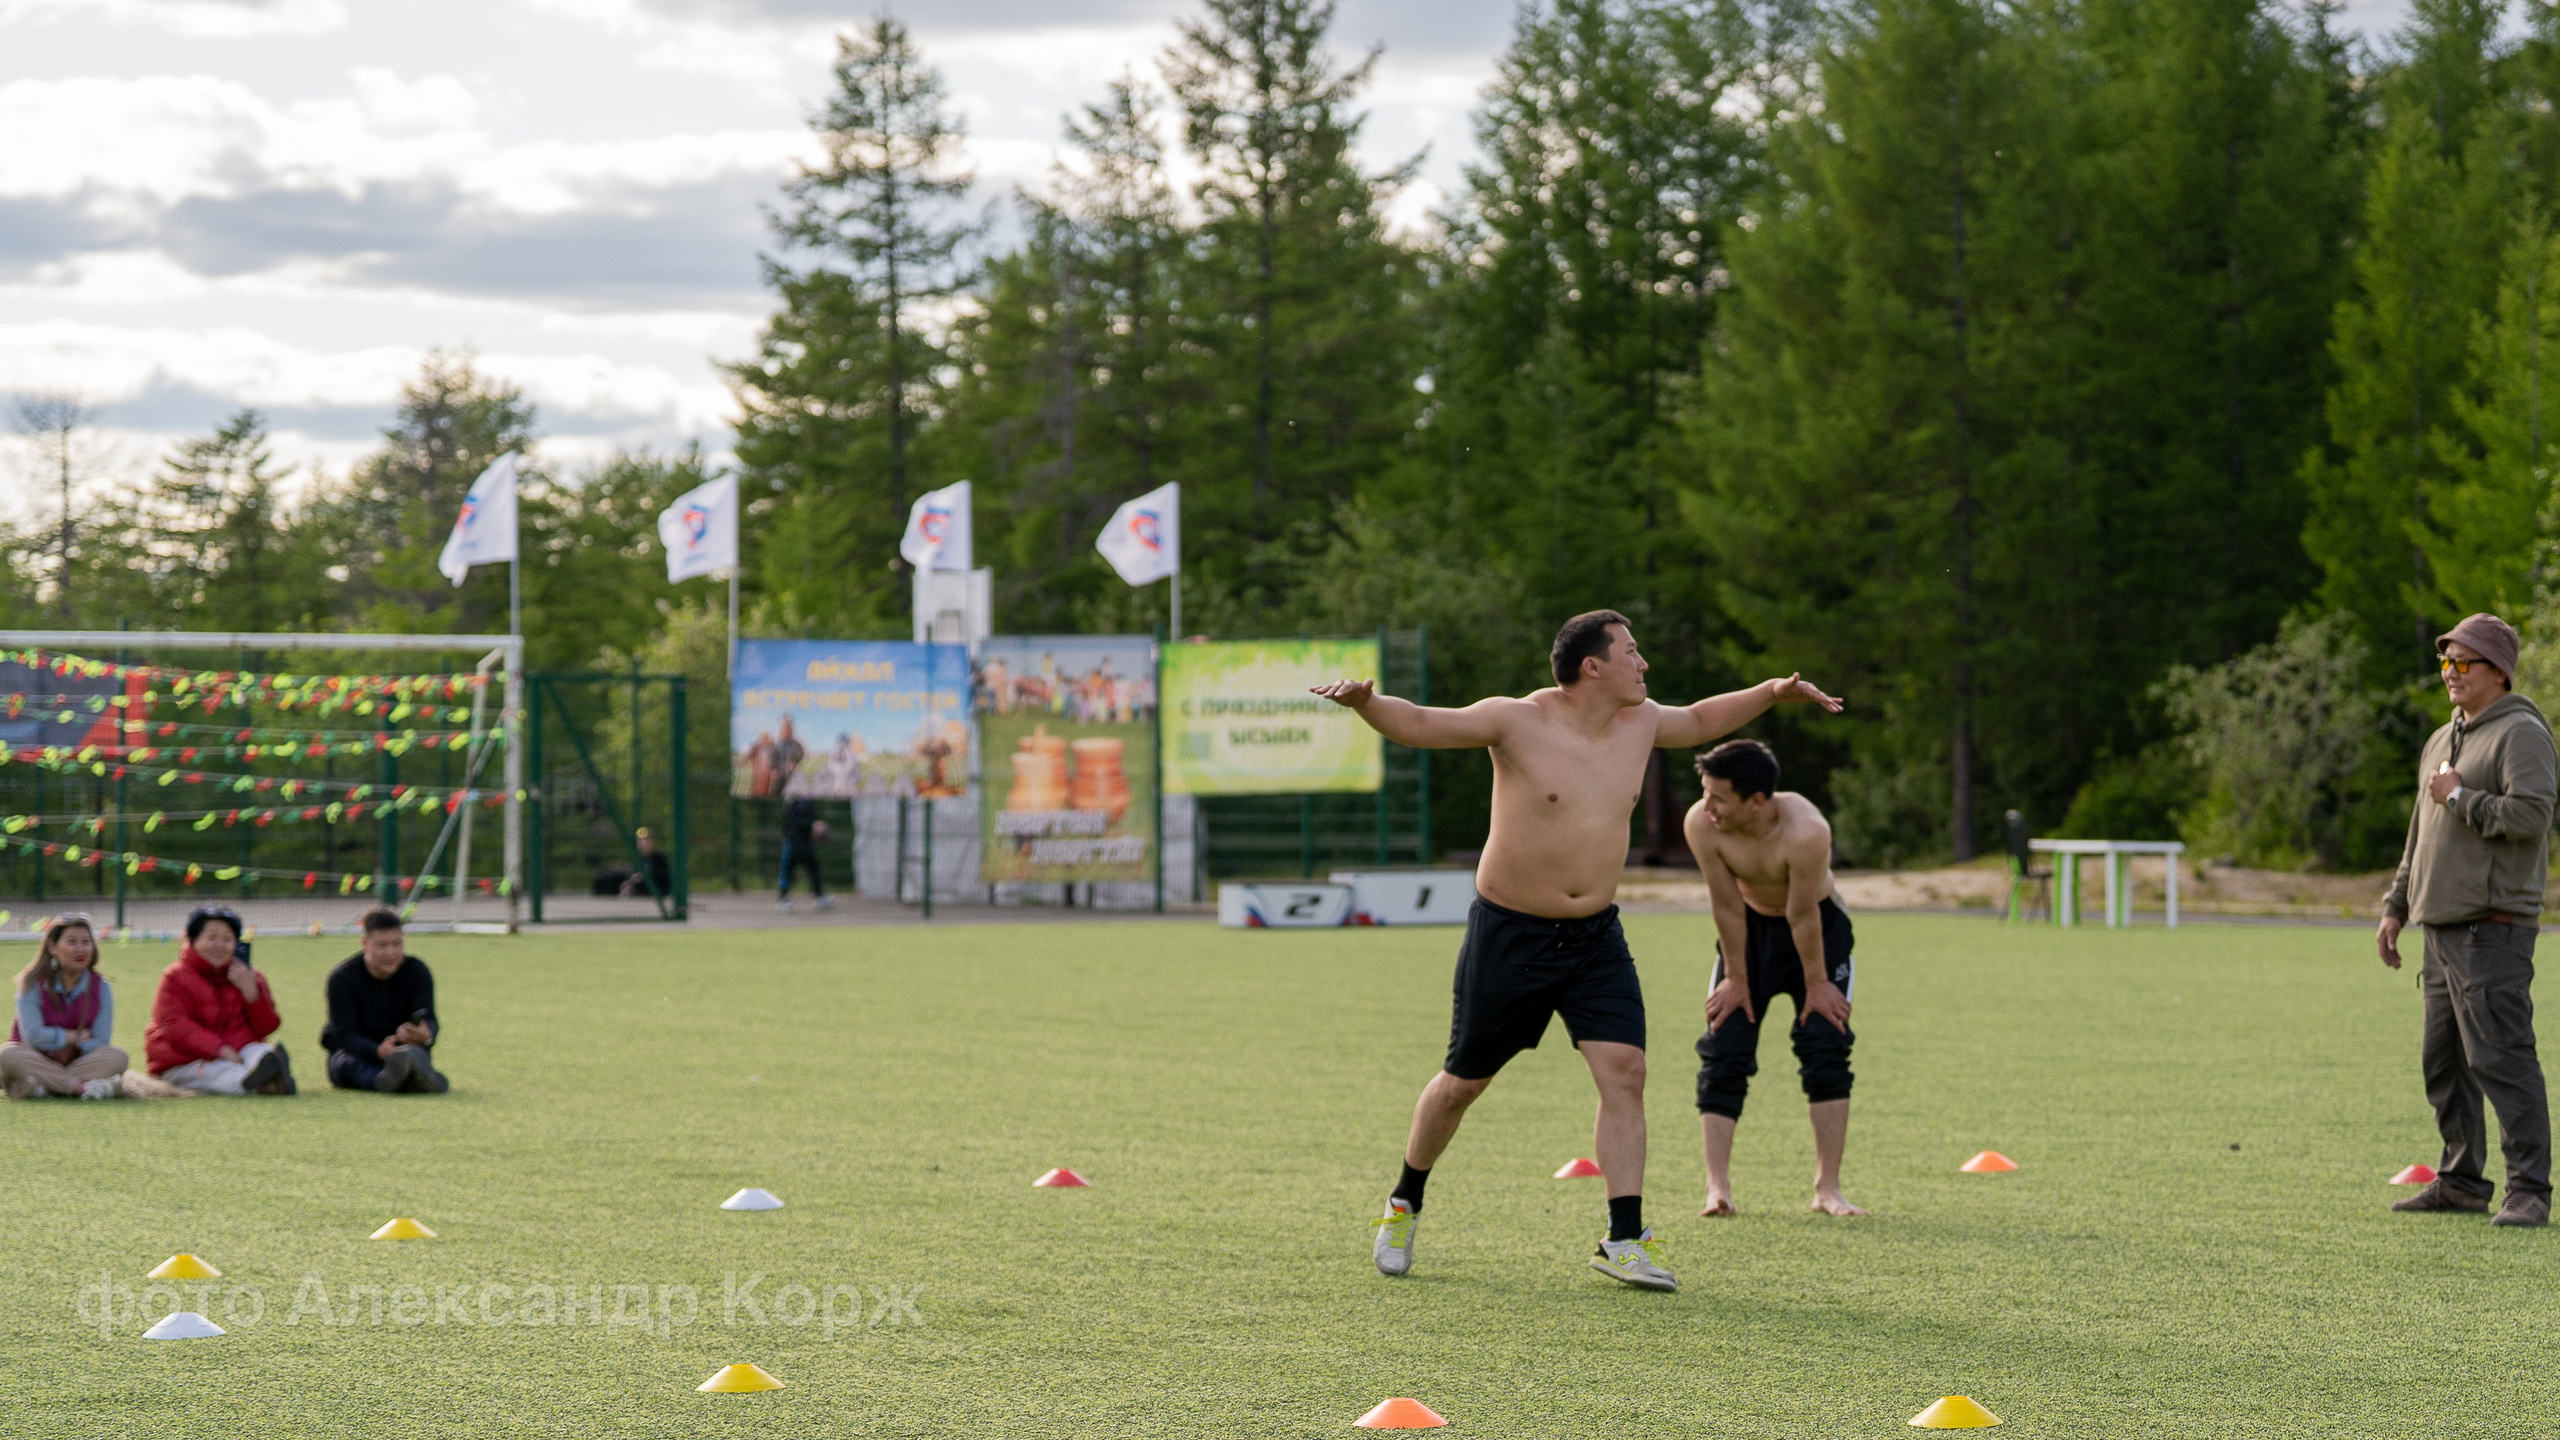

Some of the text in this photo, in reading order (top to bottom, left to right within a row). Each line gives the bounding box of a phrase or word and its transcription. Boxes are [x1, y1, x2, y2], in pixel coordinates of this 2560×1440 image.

[743, 686, 958, 711] ВСТРЕЧАЕТ ГОСТЕЙ
[1283, 893, 1323, 918] 2
[1415, 885, 1432, 910] 1
